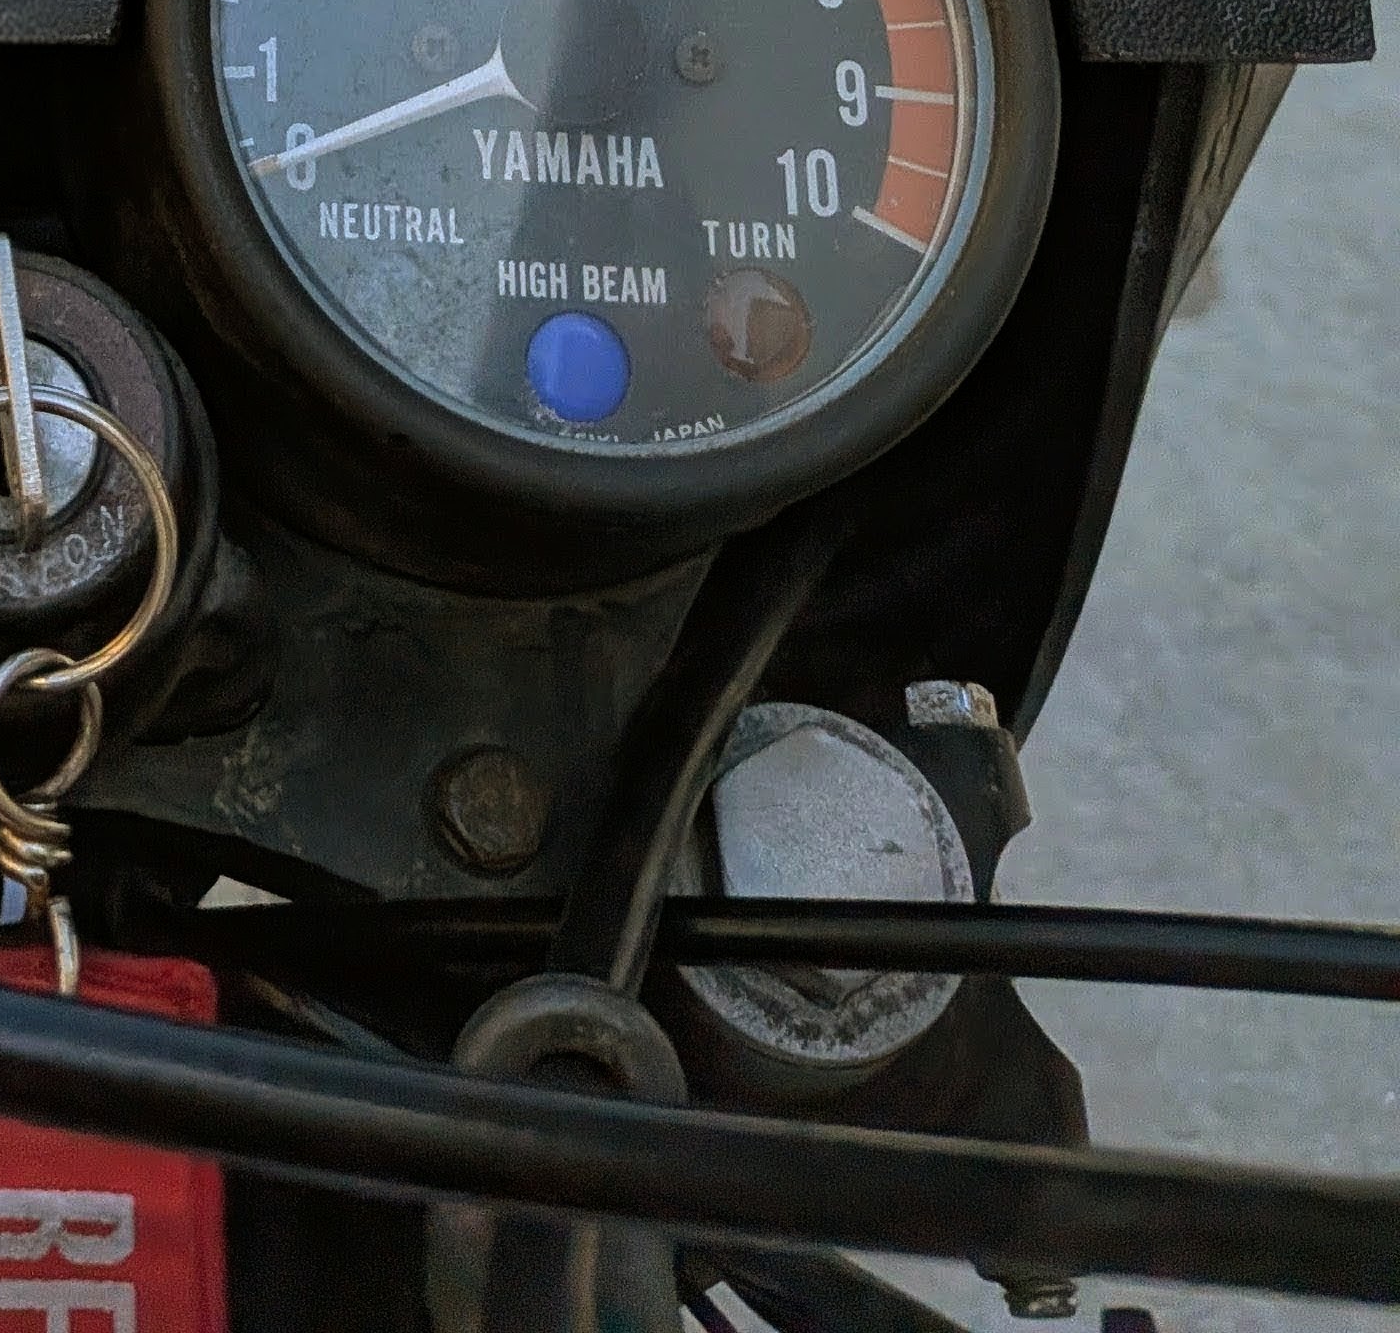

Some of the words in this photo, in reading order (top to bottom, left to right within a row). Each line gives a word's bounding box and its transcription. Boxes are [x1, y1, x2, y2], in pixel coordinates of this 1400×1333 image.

[259, 37, 278, 104] 1
[835, 62, 866, 126] 9
[286, 123, 316, 190] 0
[473, 129, 665, 189] YAMAHA
[776, 148, 839, 218] 10
[319, 201, 464, 245] NEUTRAL
[703, 221, 797, 260] TURN
[498, 259, 569, 301] HIGH
[582, 265, 667, 305] BEAM
